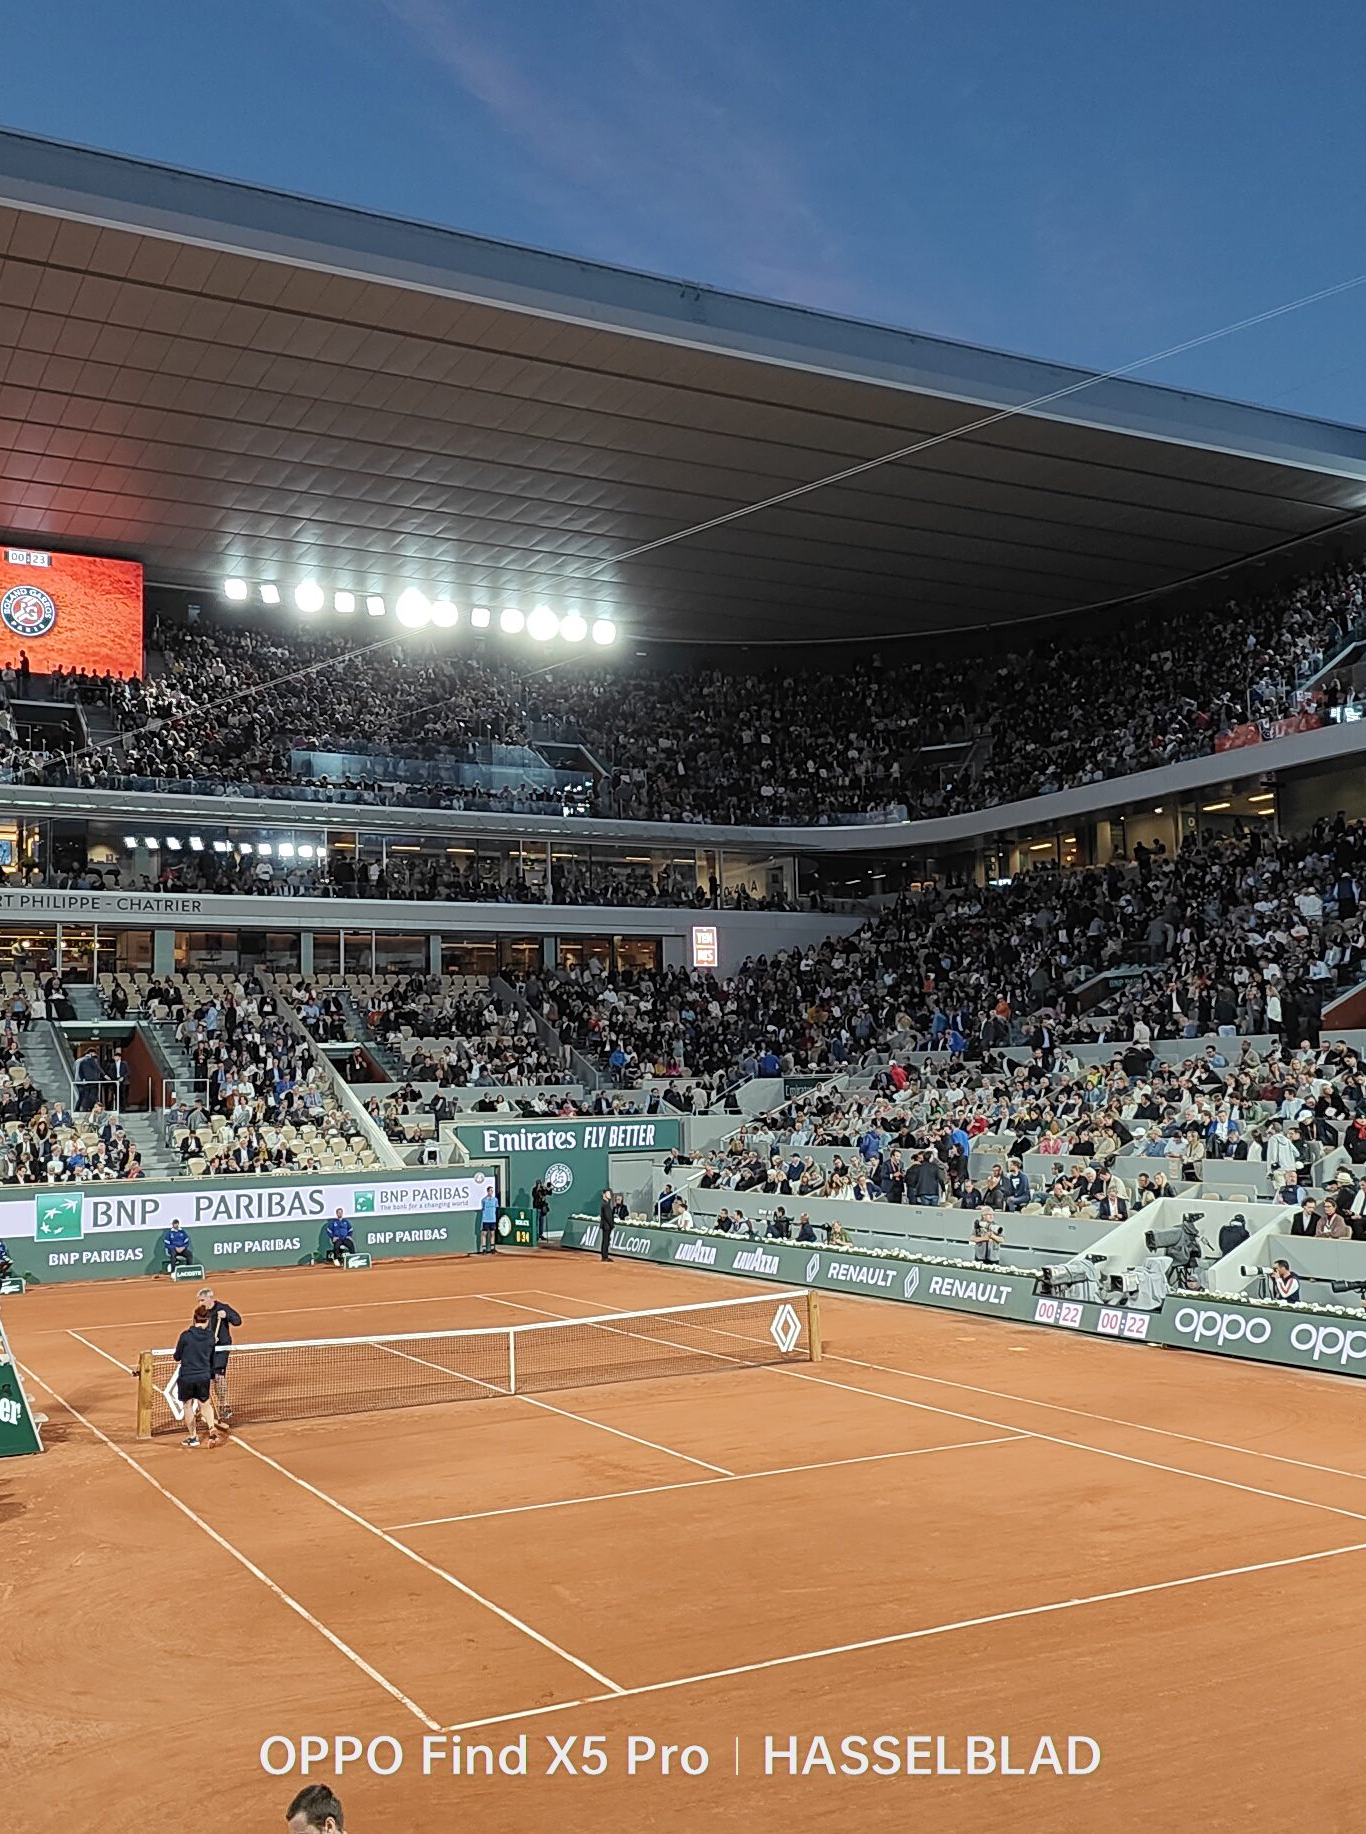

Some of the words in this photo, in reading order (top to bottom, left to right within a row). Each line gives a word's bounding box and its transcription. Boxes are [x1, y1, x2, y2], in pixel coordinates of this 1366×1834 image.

[20, 894, 100, 910] PHILIPPE
[116, 897, 202, 912] CHATRIER
[483, 1128, 577, 1152] Emirates
[583, 1126, 607, 1148] FLY
[608, 1124, 655, 1147] BETTER
[380, 1189, 408, 1204] BNP
[412, 1186, 469, 1202] PARIBAS
[93, 1199, 160, 1228] BNP
[195, 1189, 325, 1222] PARIBAS
[214, 1242, 242, 1255] BNP
[244, 1238, 301, 1252] PARIBAS
[367, 1231, 393, 1244] BNP
[396, 1228, 447, 1242] PARIBAS
[48, 1252, 79, 1266] BNP
[82, 1248, 144, 1264] PARIBAS
[674, 1239, 717, 1265] LAVAZZA
[732, 1248, 779, 1275] LAVAZZA
[827, 1262, 897, 1287] RENAULT
[929, 1276, 1012, 1305] RENAULT
[1038, 1303, 1079, 1324] 00:22
[1101, 1312, 1146, 1334] 00:22
[1175, 1307, 1271, 1345] oppo
